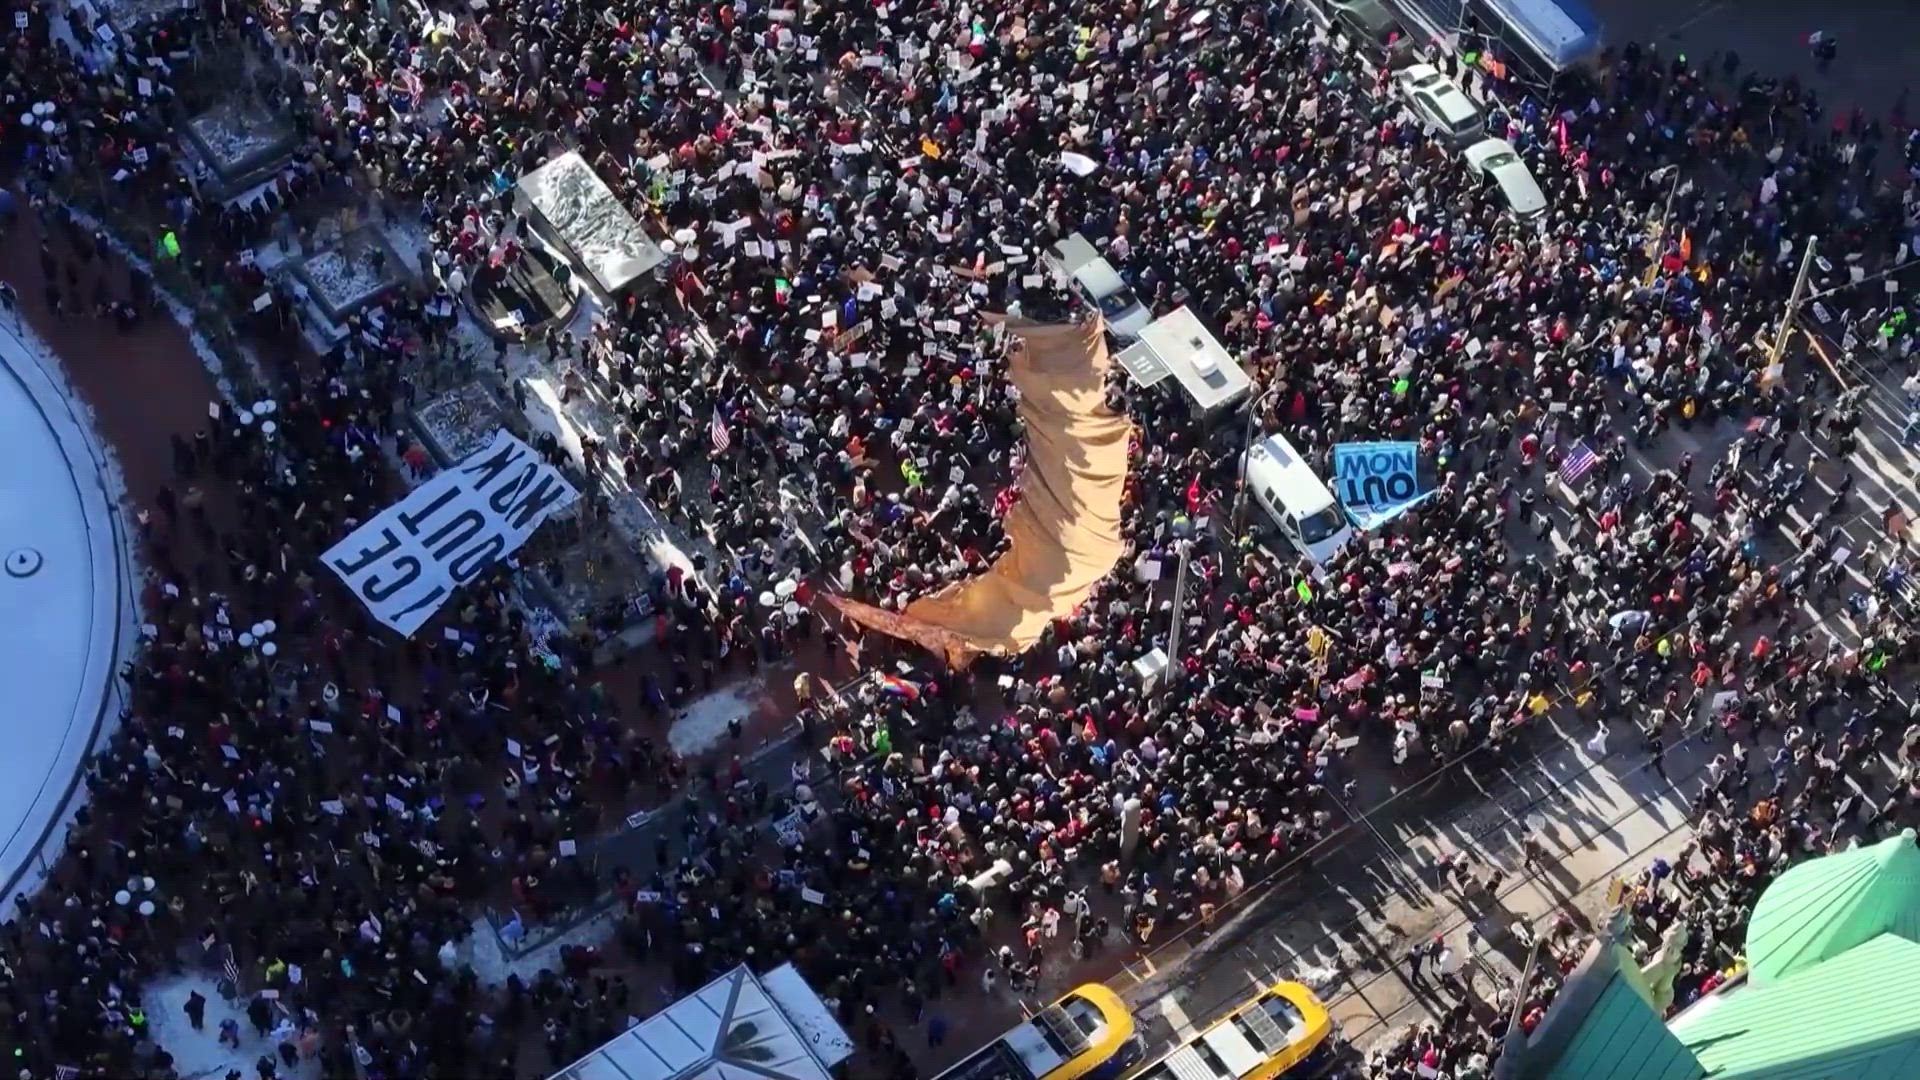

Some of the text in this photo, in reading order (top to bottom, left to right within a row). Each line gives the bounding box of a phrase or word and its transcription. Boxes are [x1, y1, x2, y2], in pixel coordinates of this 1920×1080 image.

[462, 442, 565, 530] NOW
[1342, 451, 1413, 479] NOW
[1345, 472, 1415, 506] OUT
[333, 528, 446, 623] ICE
[398, 485, 505, 582] OUT
